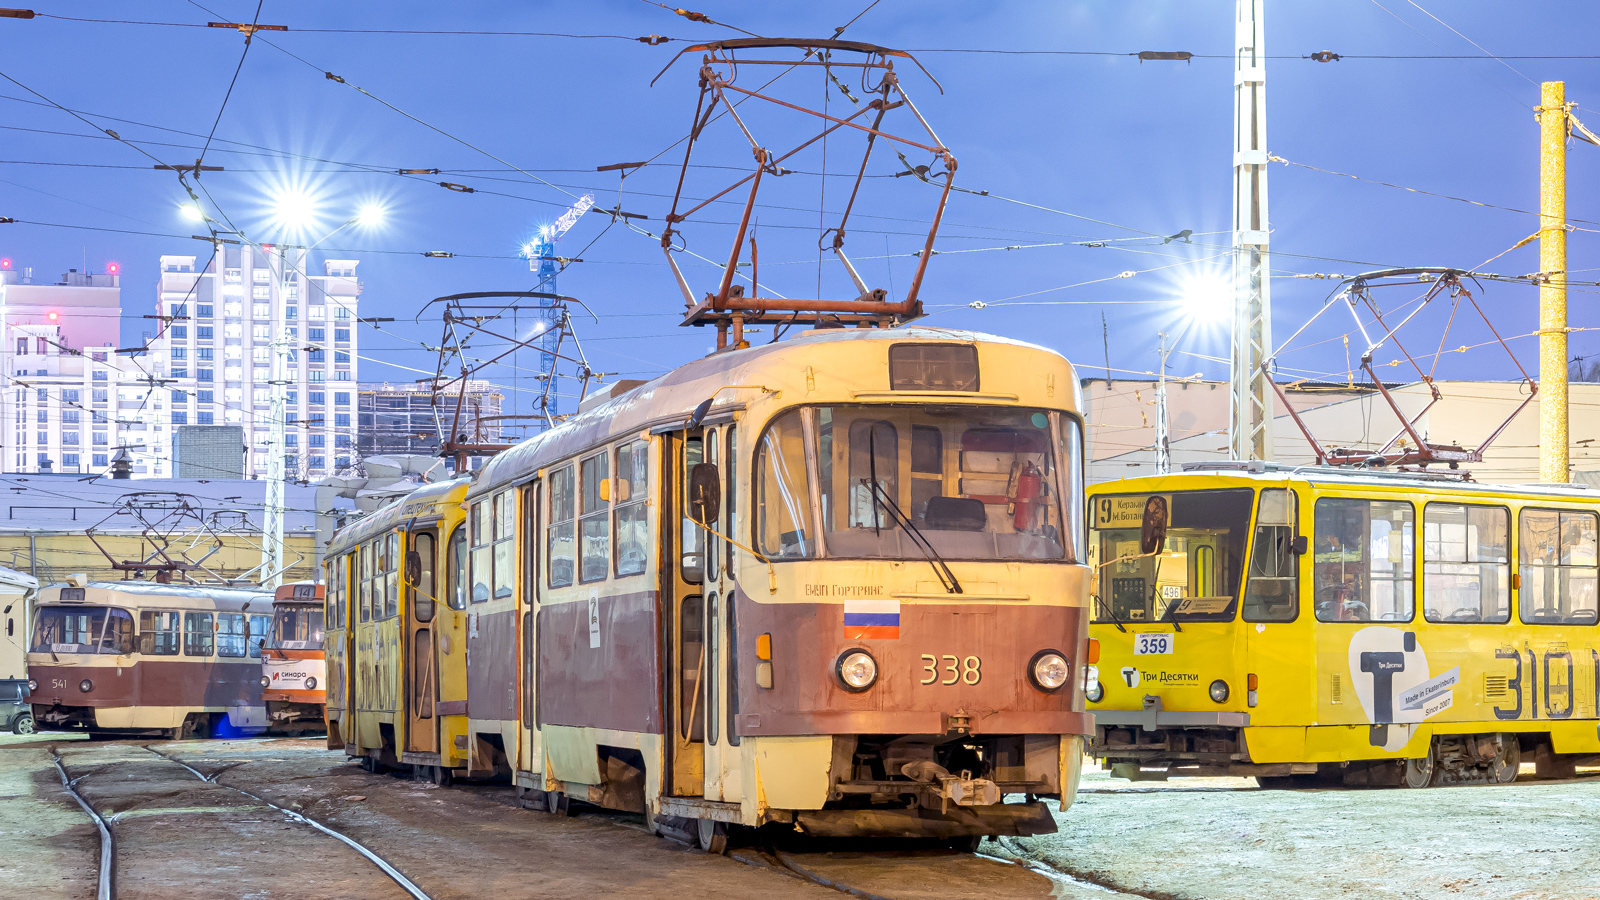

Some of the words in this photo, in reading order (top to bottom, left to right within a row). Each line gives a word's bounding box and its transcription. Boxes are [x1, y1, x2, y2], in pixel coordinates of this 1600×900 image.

[1100, 499, 1112, 523] 9
[299, 587, 311, 597] 14
[1163, 587, 1180, 597] 496
[1178, 600, 1192, 611] 9
[1139, 638, 1168, 654] 359
[920, 653, 982, 686] 338
[1141, 671, 1157, 682] Три
[1159, 671, 1199, 682] Десятки
[52, 679, 67, 688] 541
[1405, 692, 1419, 705] Made
[1420, 690, 1425, 698] in
[1425, 703, 1439, 716] Since
[1439, 697, 1451, 710] 2007
